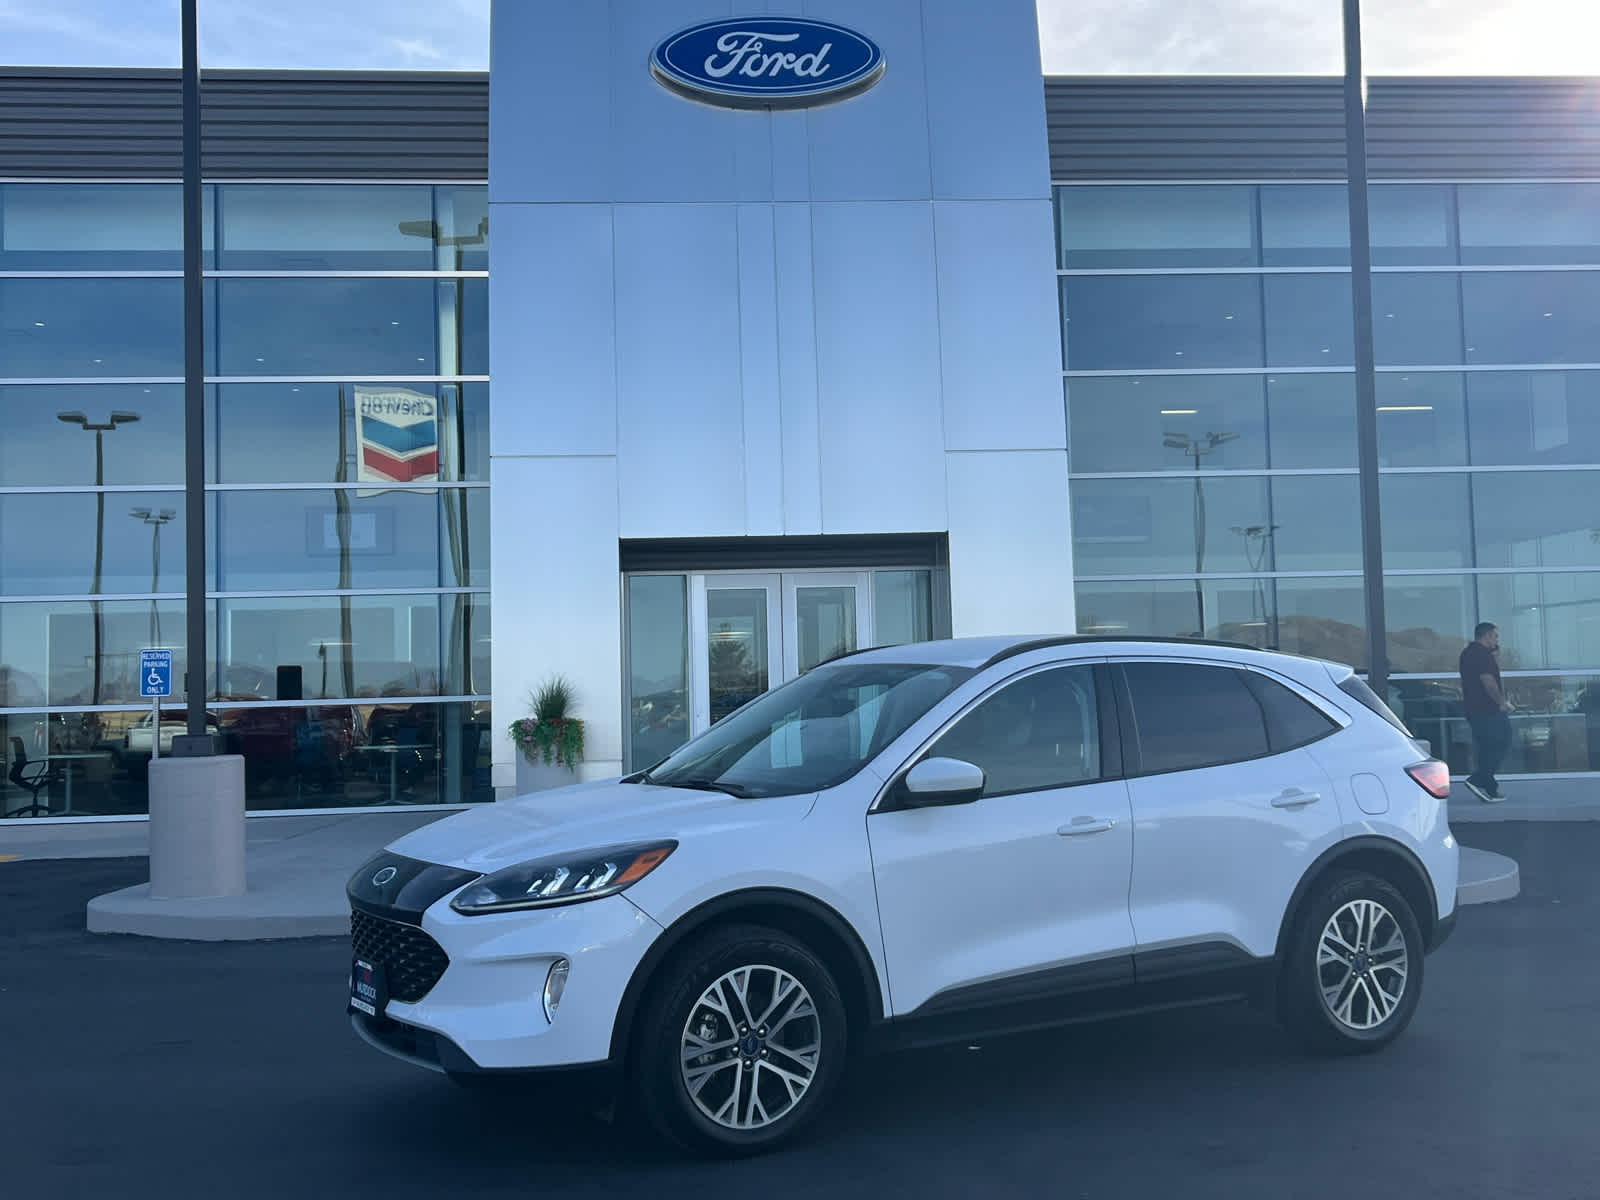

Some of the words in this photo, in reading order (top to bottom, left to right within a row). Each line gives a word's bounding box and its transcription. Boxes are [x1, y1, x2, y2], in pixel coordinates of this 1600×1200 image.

[704, 31, 832, 78] Ford
[142, 652, 170, 660] RESERVED
[143, 660, 169, 668] PARKING
[146, 686, 165, 694] ONLY
